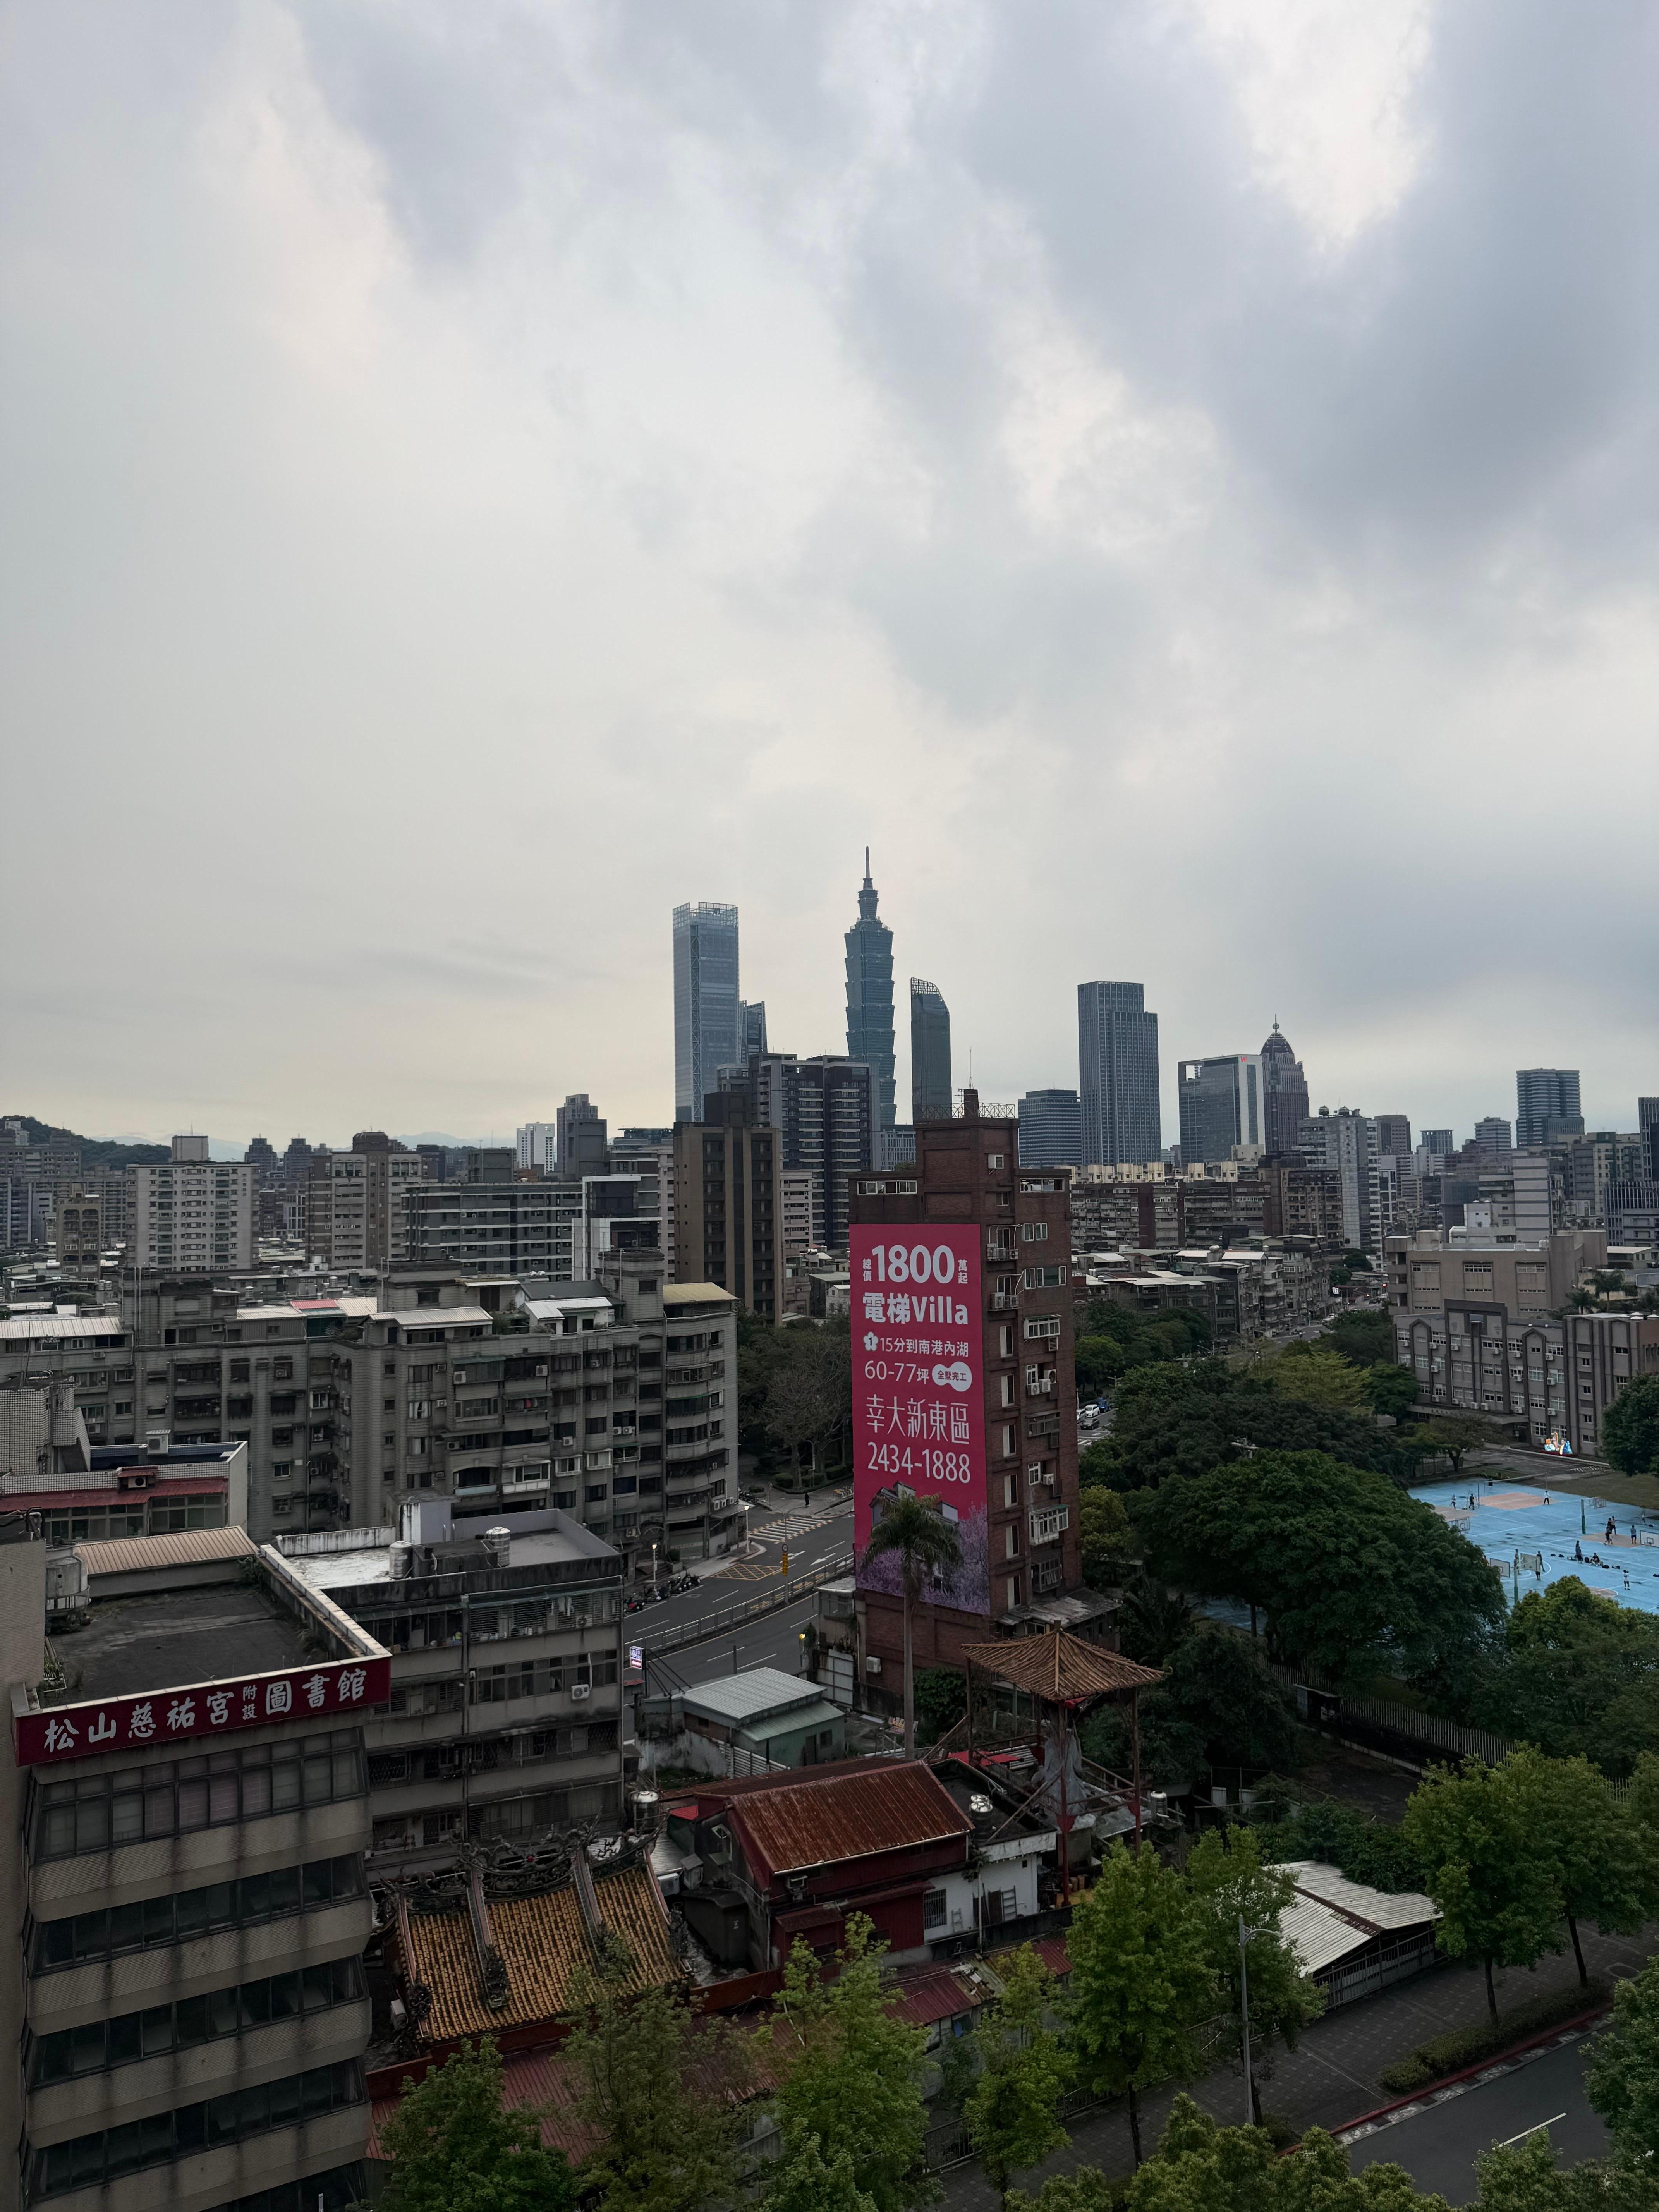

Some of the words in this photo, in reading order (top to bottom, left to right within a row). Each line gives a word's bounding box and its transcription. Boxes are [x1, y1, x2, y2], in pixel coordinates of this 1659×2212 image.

[872, 1245, 955, 1284] 1800
[880, 1337, 968, 1357] 15分到南港內湖
[865, 1360, 929, 1384] 60-77坪
[938, 1370, 967, 1381] 全墅完工
[866, 1394, 969, 1444] 幸大新東區
[868, 1442, 970, 1483] 2434-1888
